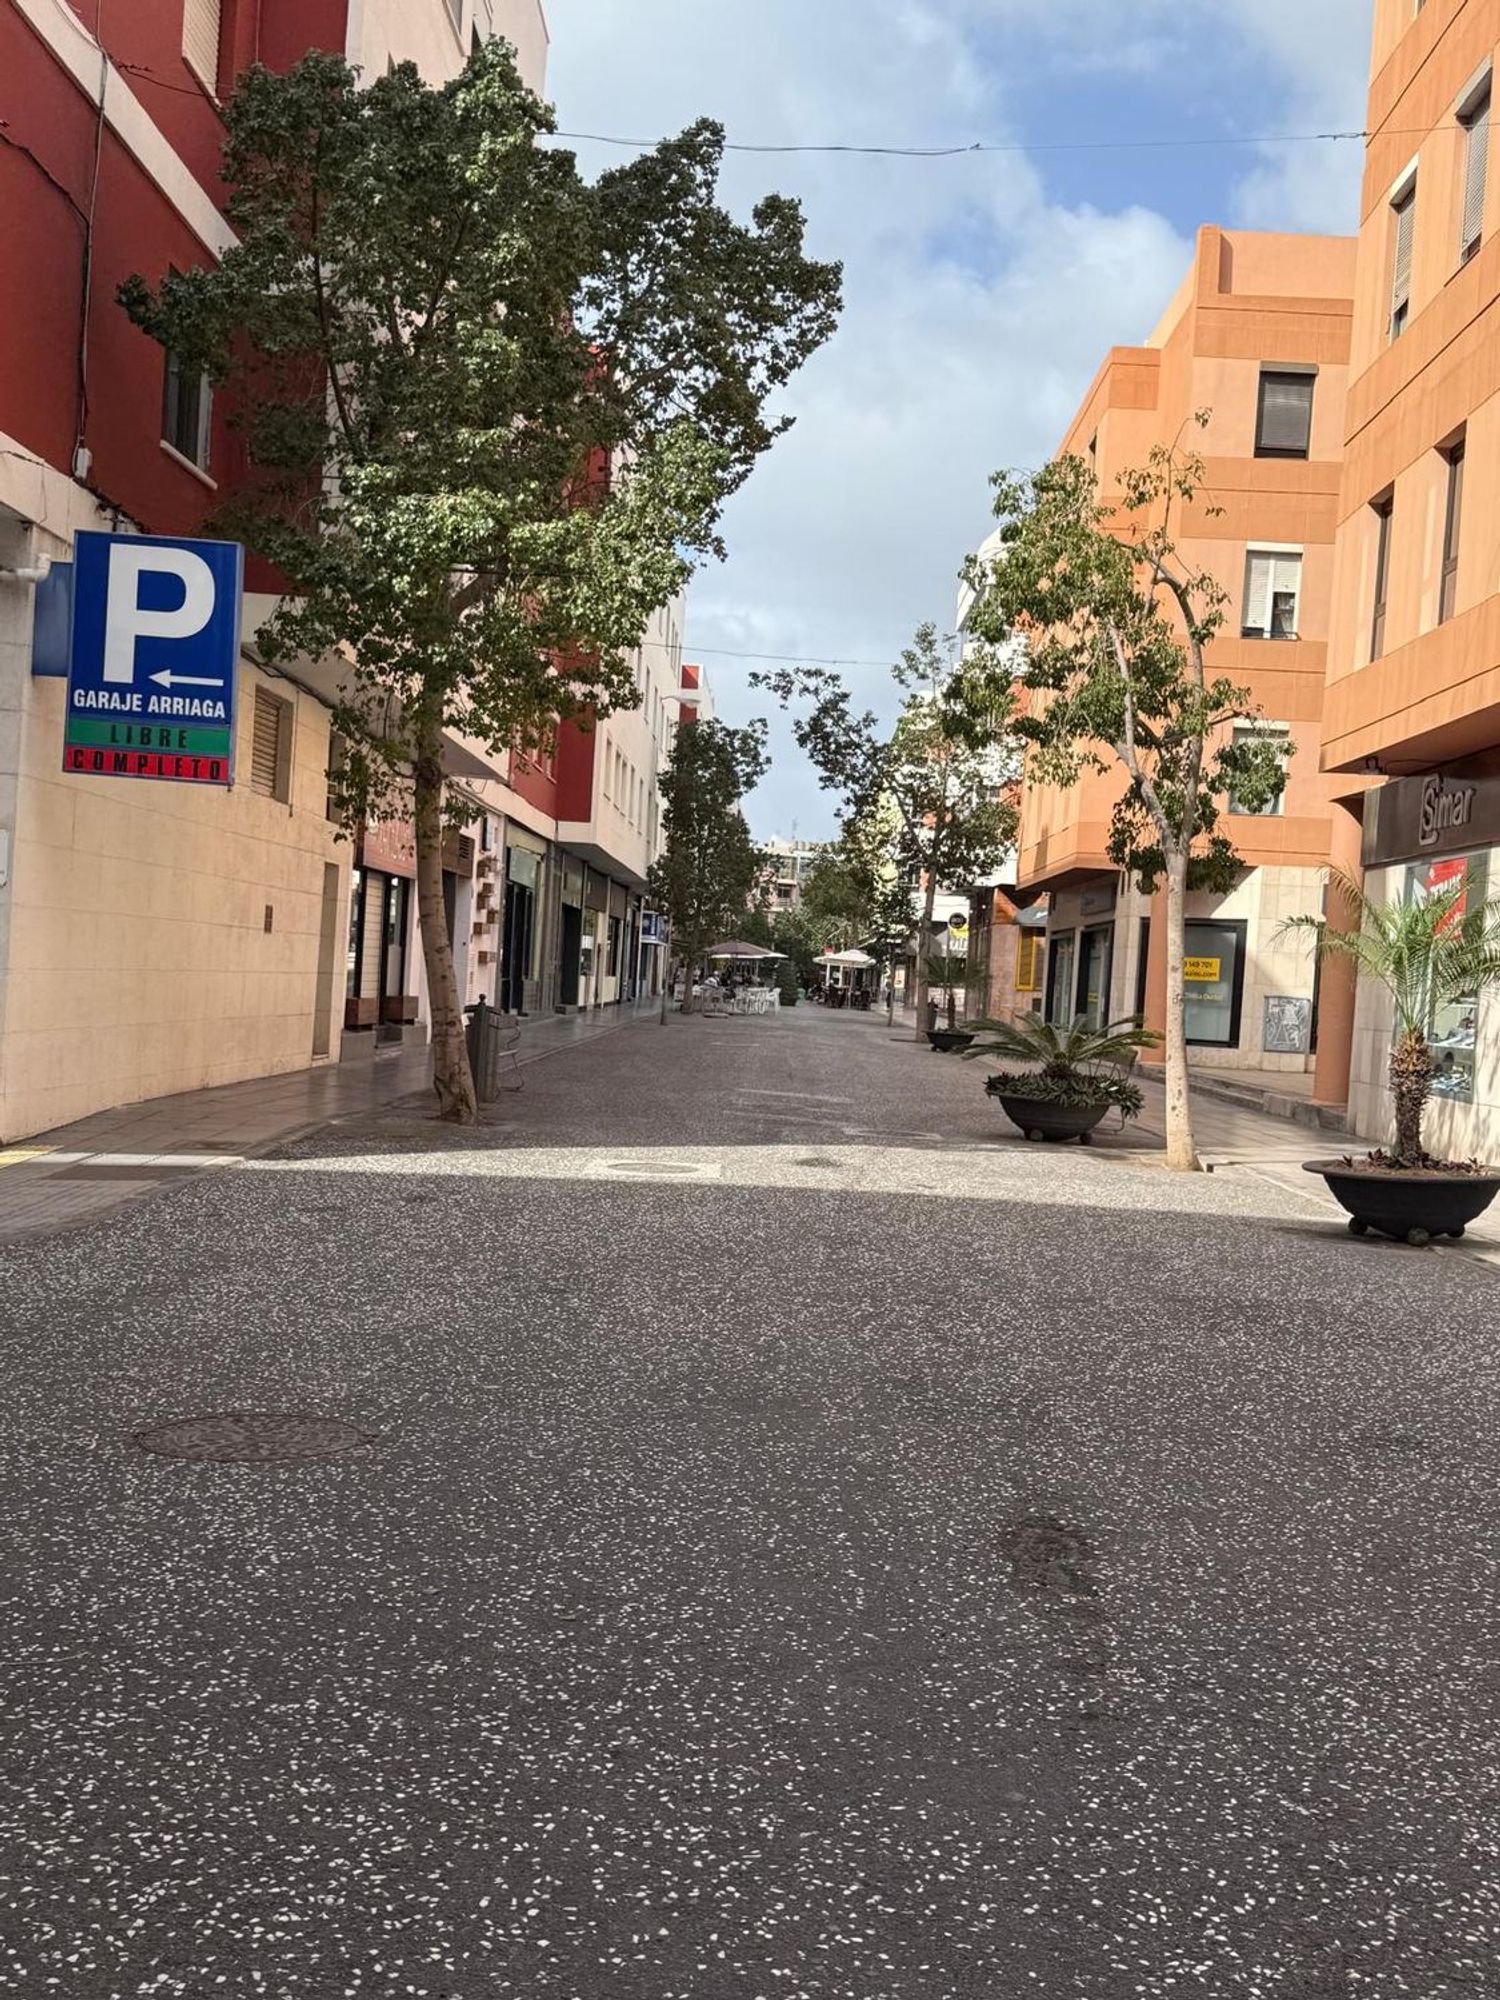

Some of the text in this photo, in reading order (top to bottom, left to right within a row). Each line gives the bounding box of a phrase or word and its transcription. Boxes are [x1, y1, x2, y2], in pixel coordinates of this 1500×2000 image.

[103, 543, 215, 684] P
[73, 689, 226, 719] GARAJE ARRIAGA
[110, 724, 188, 748] LIBRE
[73, 749, 220, 780] COMPLETO
[1420, 778, 1473, 839] Simar
